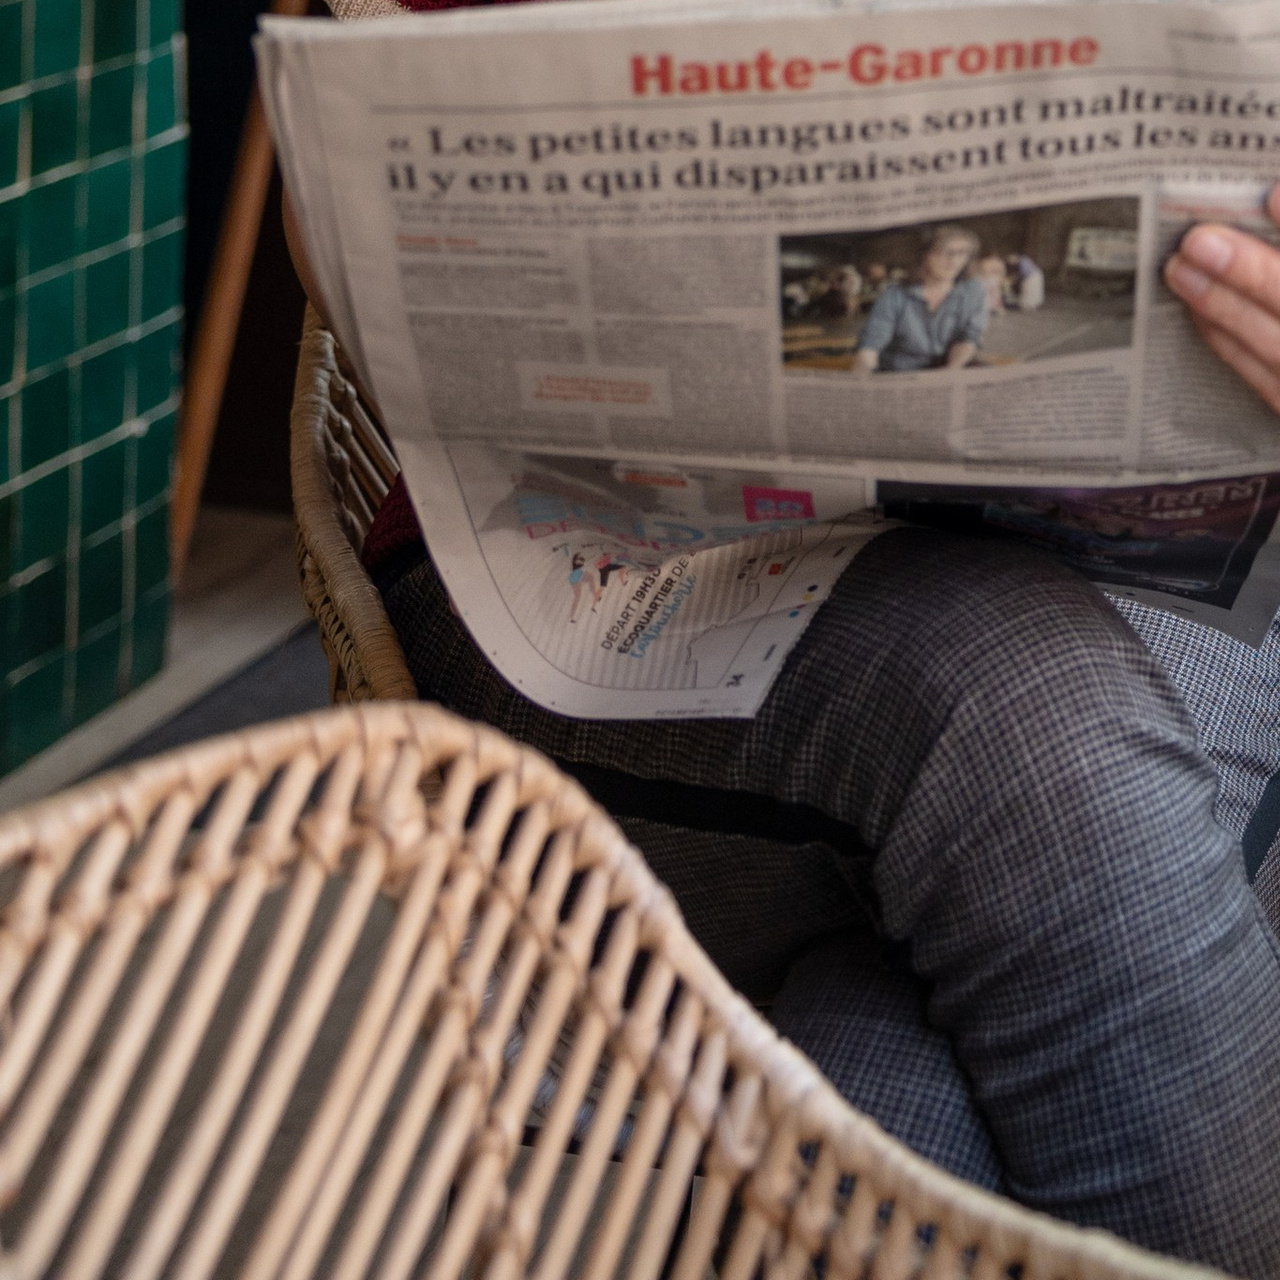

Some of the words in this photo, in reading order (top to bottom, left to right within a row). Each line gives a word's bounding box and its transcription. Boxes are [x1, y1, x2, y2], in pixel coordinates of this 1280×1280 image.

[630, 36, 1100, 96] Haute-Garonne
[386, 161, 418, 193] il
[428, 170, 456, 201] y
[468, 169, 531, 195] en
[543, 170, 570, 195] a
[581, 160, 662, 199] qui
[674, 142, 1006, 196] disparaissent
[1018, 128, 1122, 162] tous
[1133, 121, 1199, 151] les
[428, 125, 517, 158] Les
[528, 122, 698, 162] petites
[710, 115, 911, 156] langues
[922, 97, 1026, 134] sont
[601, 604, 636, 650] DÉPART
[618, 577, 677, 654] ÉCOQUARTIER
[672, 558, 689, 577] DE
